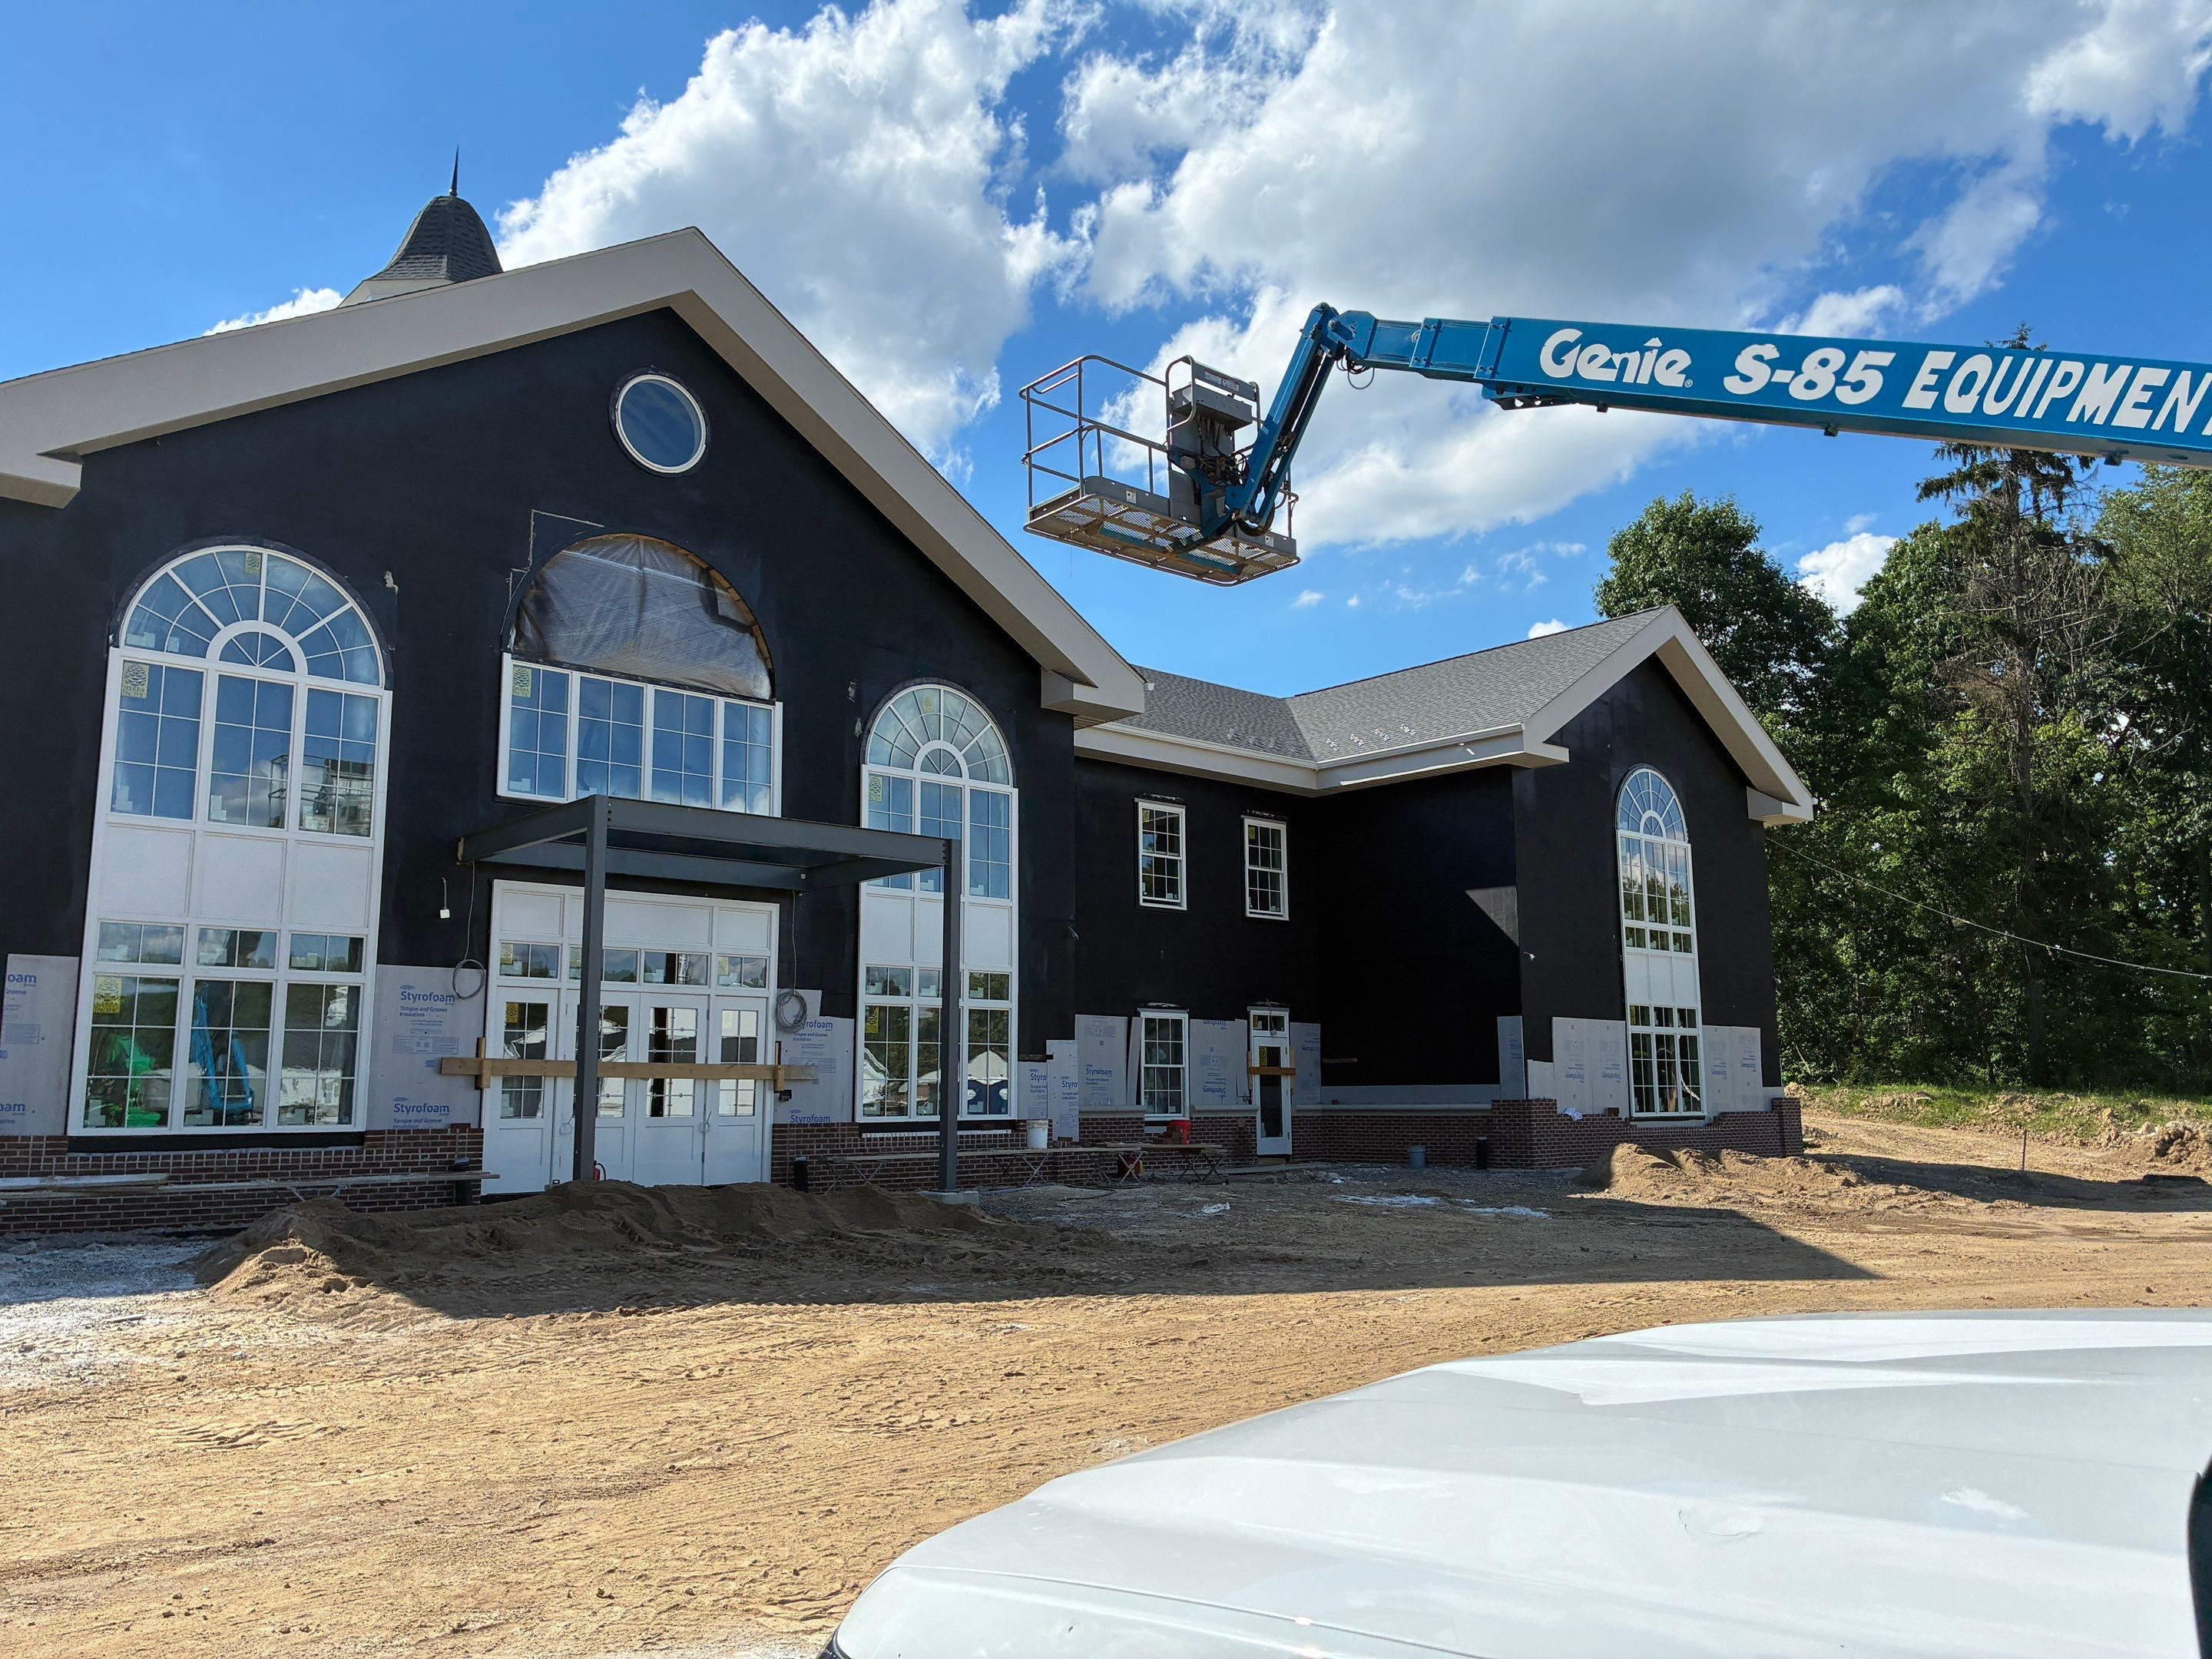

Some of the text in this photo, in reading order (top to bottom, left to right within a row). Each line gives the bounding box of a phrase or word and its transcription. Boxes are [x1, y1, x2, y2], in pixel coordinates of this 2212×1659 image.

[1540, 328, 2212, 436] Genie S-85 EQUIPMEN
[400, 992, 455, 1003] Styrofoam
[1030, 1073, 1047, 1082] Styro
[393, 1104, 449, 1115] Styrofoam
[790, 1114, 830, 1124] Styrofoam
